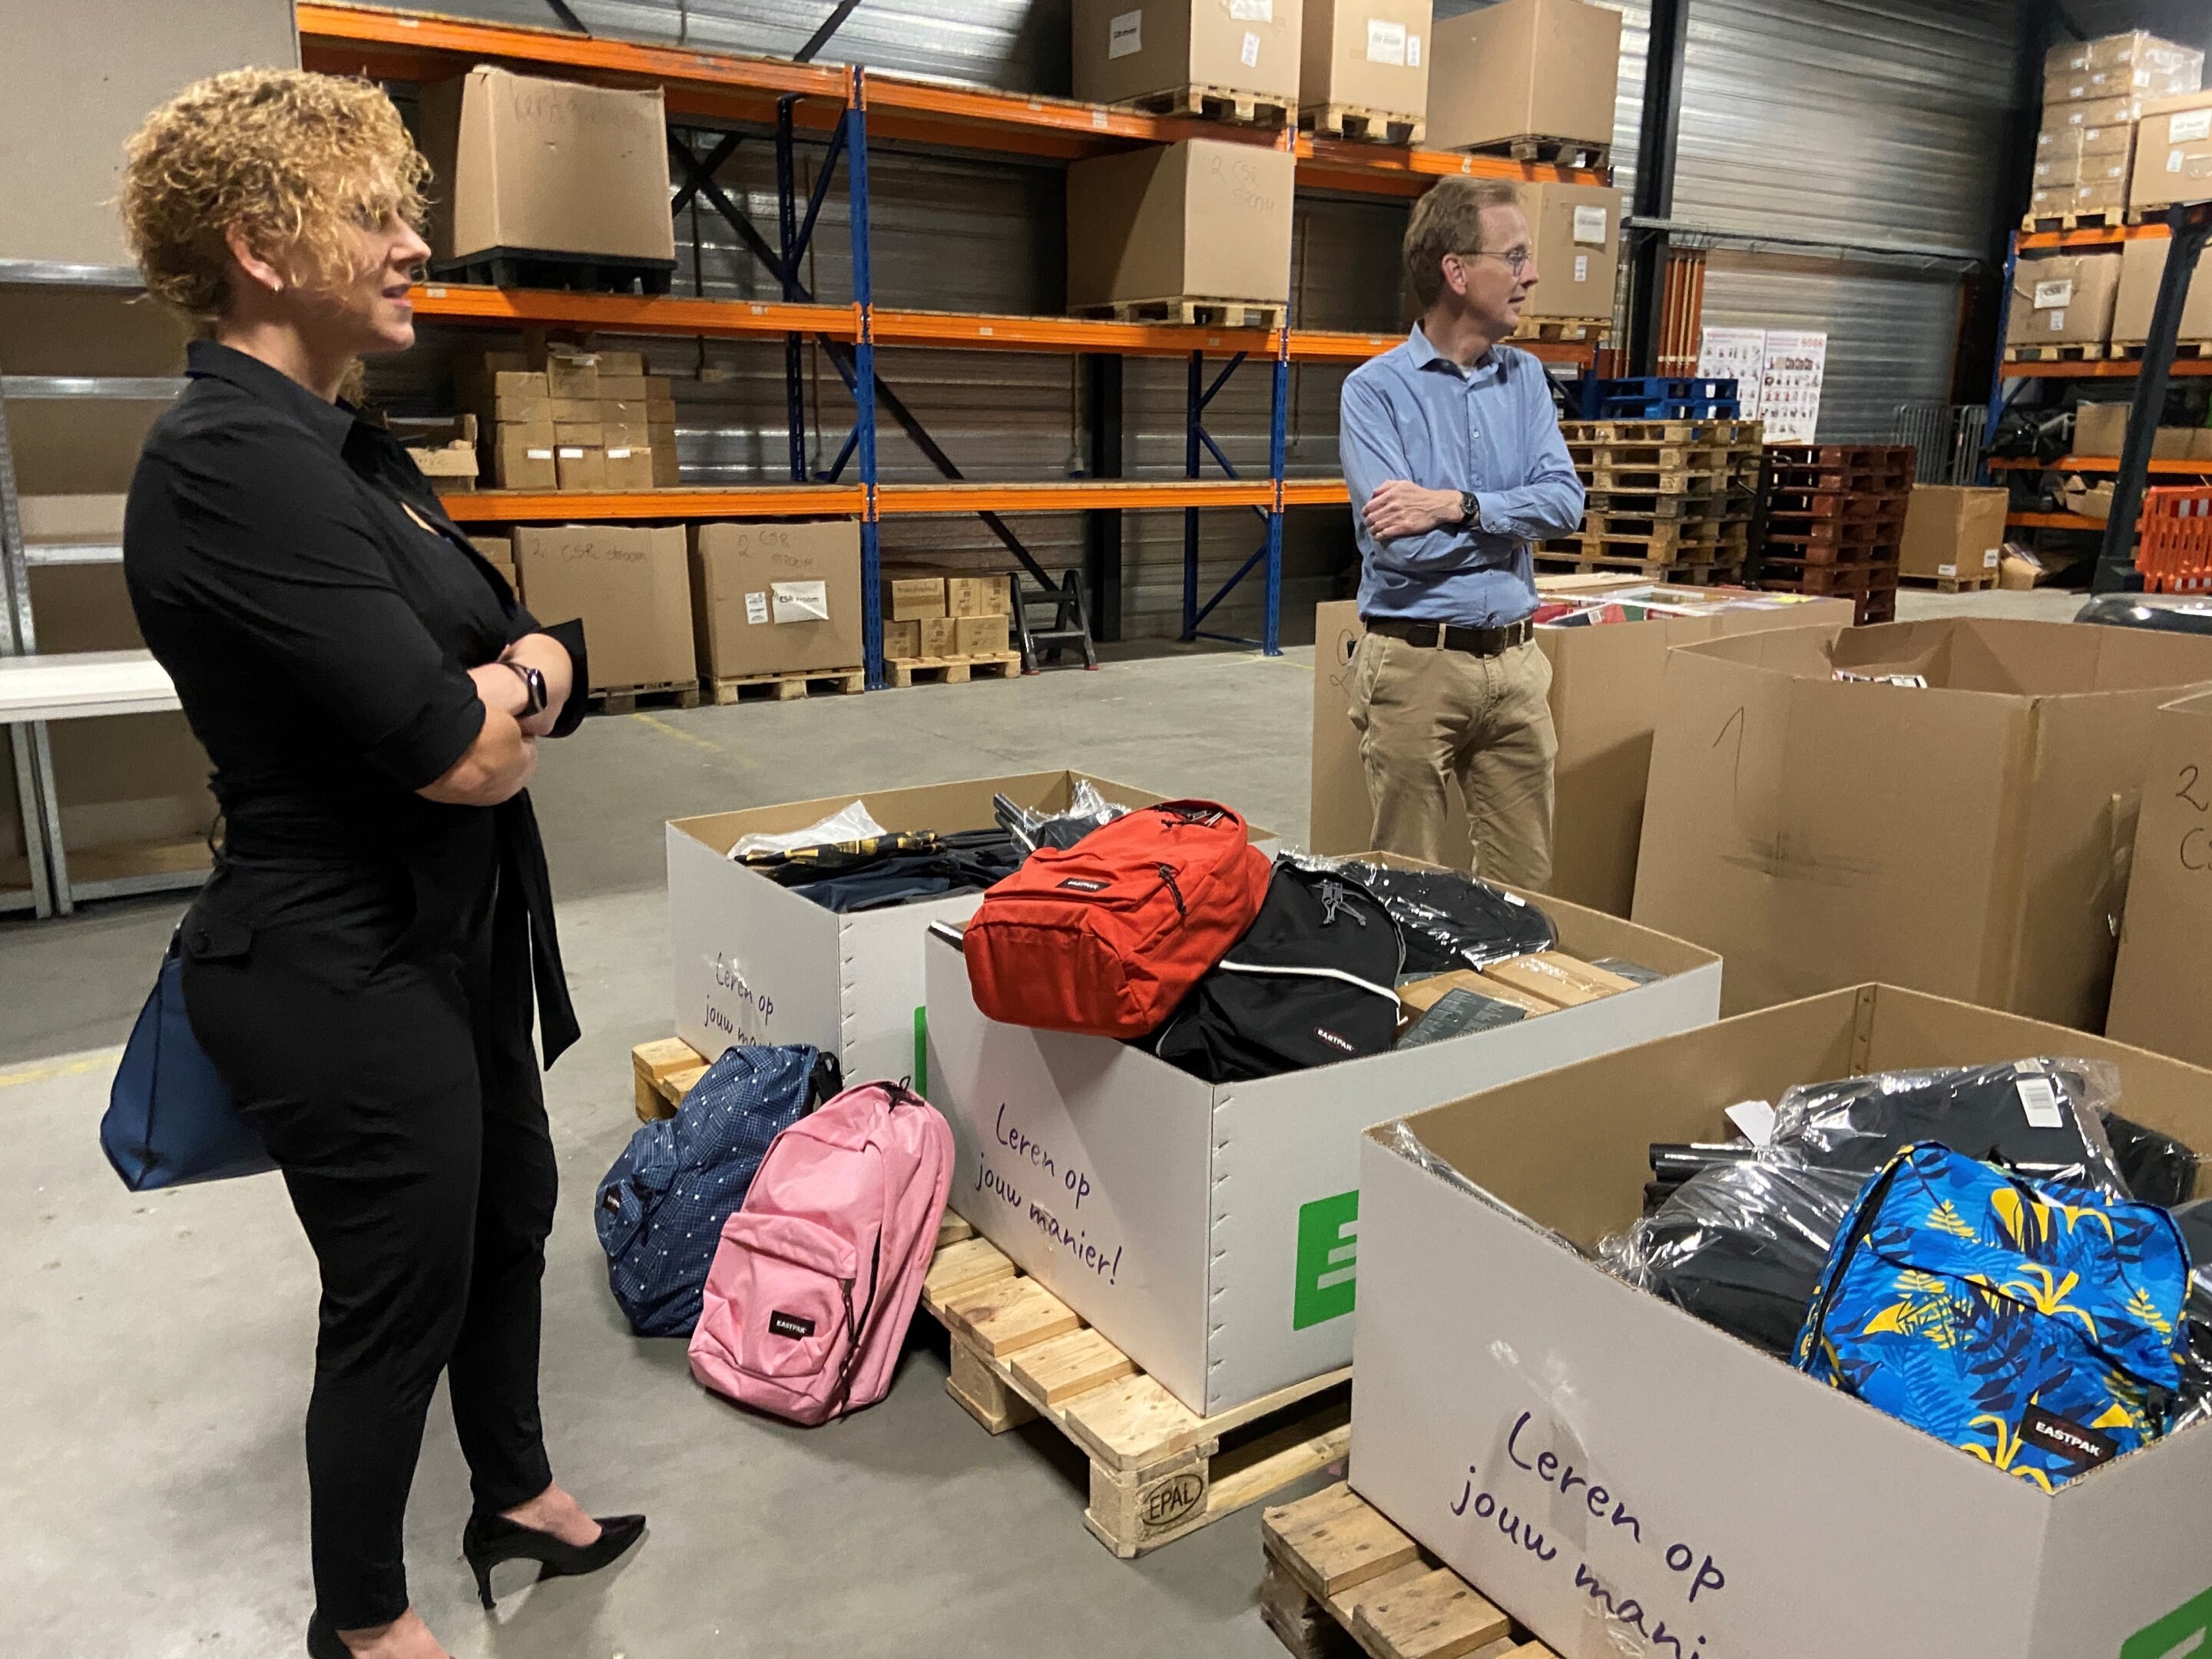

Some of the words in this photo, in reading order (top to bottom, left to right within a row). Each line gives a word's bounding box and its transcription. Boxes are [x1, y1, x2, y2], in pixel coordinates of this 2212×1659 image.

[2175, 765, 2209, 812] 2
[704, 994, 733, 1035] jouw
[758, 995, 774, 1025] op
[1317, 1029, 1353, 1051] EASTPAK
[995, 1102, 1055, 1177] Leren
[1065, 1169, 1091, 1210] op
[975, 1152, 1022, 1208] jouw
[1029, 1202, 1123, 1286] manier!
[776, 1320, 806, 1334] EASTPAK
[2035, 1421, 2101, 1457] EASTPAK
[1150, 1481, 1194, 1521] EPAL
[1450, 1465, 1558, 1561] jouw
[1508, 1411, 1641, 1544] Leren
[1665, 1543, 1725, 1603] op
